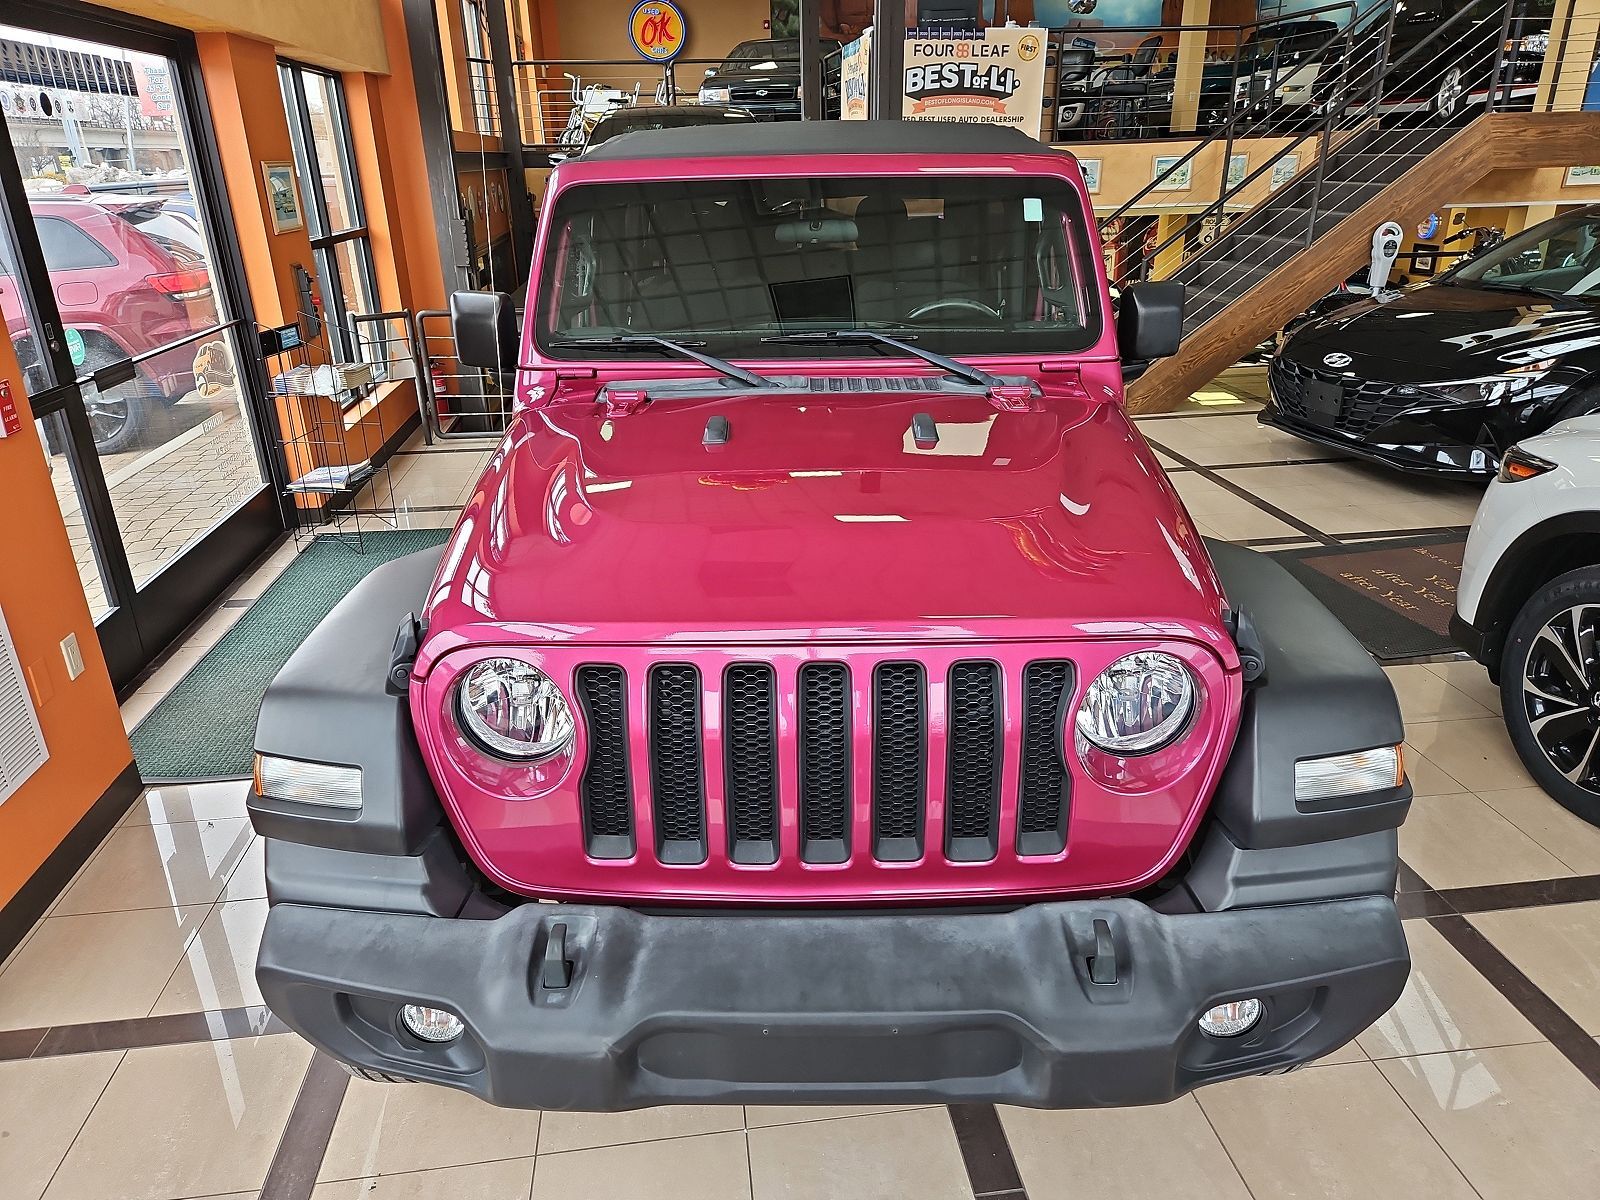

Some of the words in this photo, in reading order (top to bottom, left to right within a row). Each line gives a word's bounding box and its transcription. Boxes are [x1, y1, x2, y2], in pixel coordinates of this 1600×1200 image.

[641, 11, 675, 46] OK
[913, 44, 954, 57] FOUR
[971, 44, 1010, 57] LEAF
[1020, 44, 1037, 53] FIRST
[905, 62, 978, 94] BEST
[972, 75, 989, 88] OF
[924, 97, 995, 106] BESTOFLONGISLAND.COM
[1340, 572, 1379, 590] after
[1380, 590, 1420, 610] Year
[1371, 569, 1413, 586] after
[1414, 586, 1454, 606] Year
